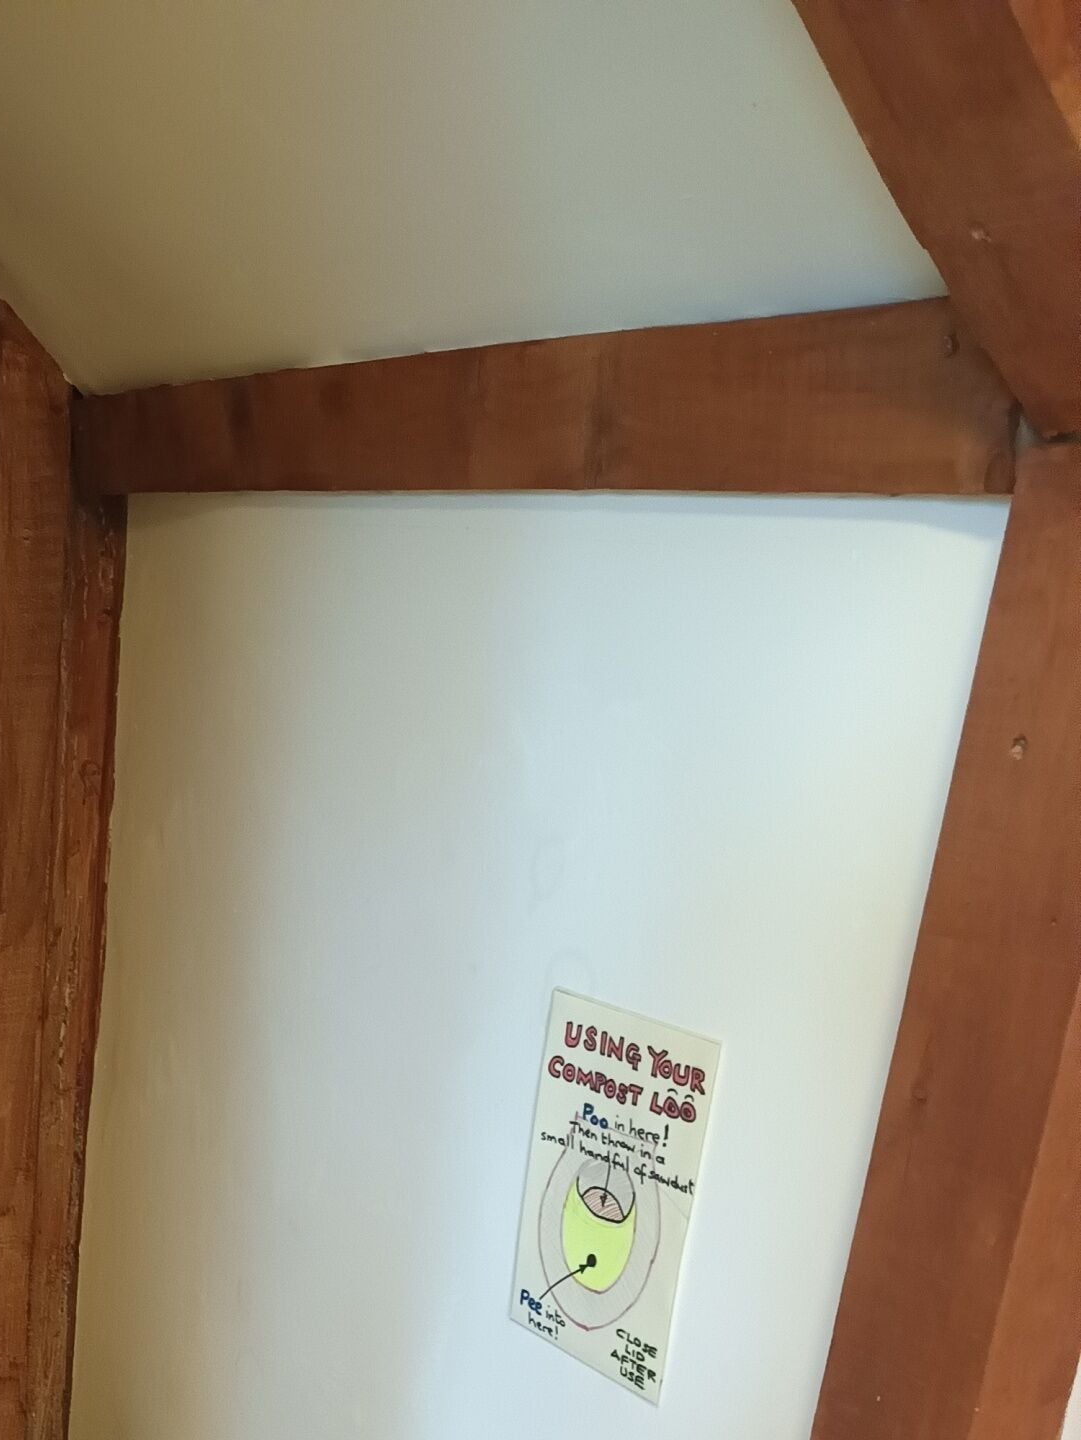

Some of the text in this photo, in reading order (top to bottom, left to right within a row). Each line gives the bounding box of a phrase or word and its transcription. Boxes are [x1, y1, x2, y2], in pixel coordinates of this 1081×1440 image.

[564, 1021, 706, 1096] USING YOUR
[548, 1055, 697, 1123] COMPOST LOO
[569, 1120, 666, 1165] Then throw in a
[582, 1103, 669, 1147] Poo in here!
[541, 1131, 695, 1196] small handful of sawdust
[520, 1288, 566, 1328] Pee into
[528, 1311, 559, 1341] here!
[616, 1328, 658, 1359] CLOSE
[624, 1344, 645, 1363] LID
[610, 1349, 657, 1383] AFTER
[619, 1366, 645, 1390] USE
